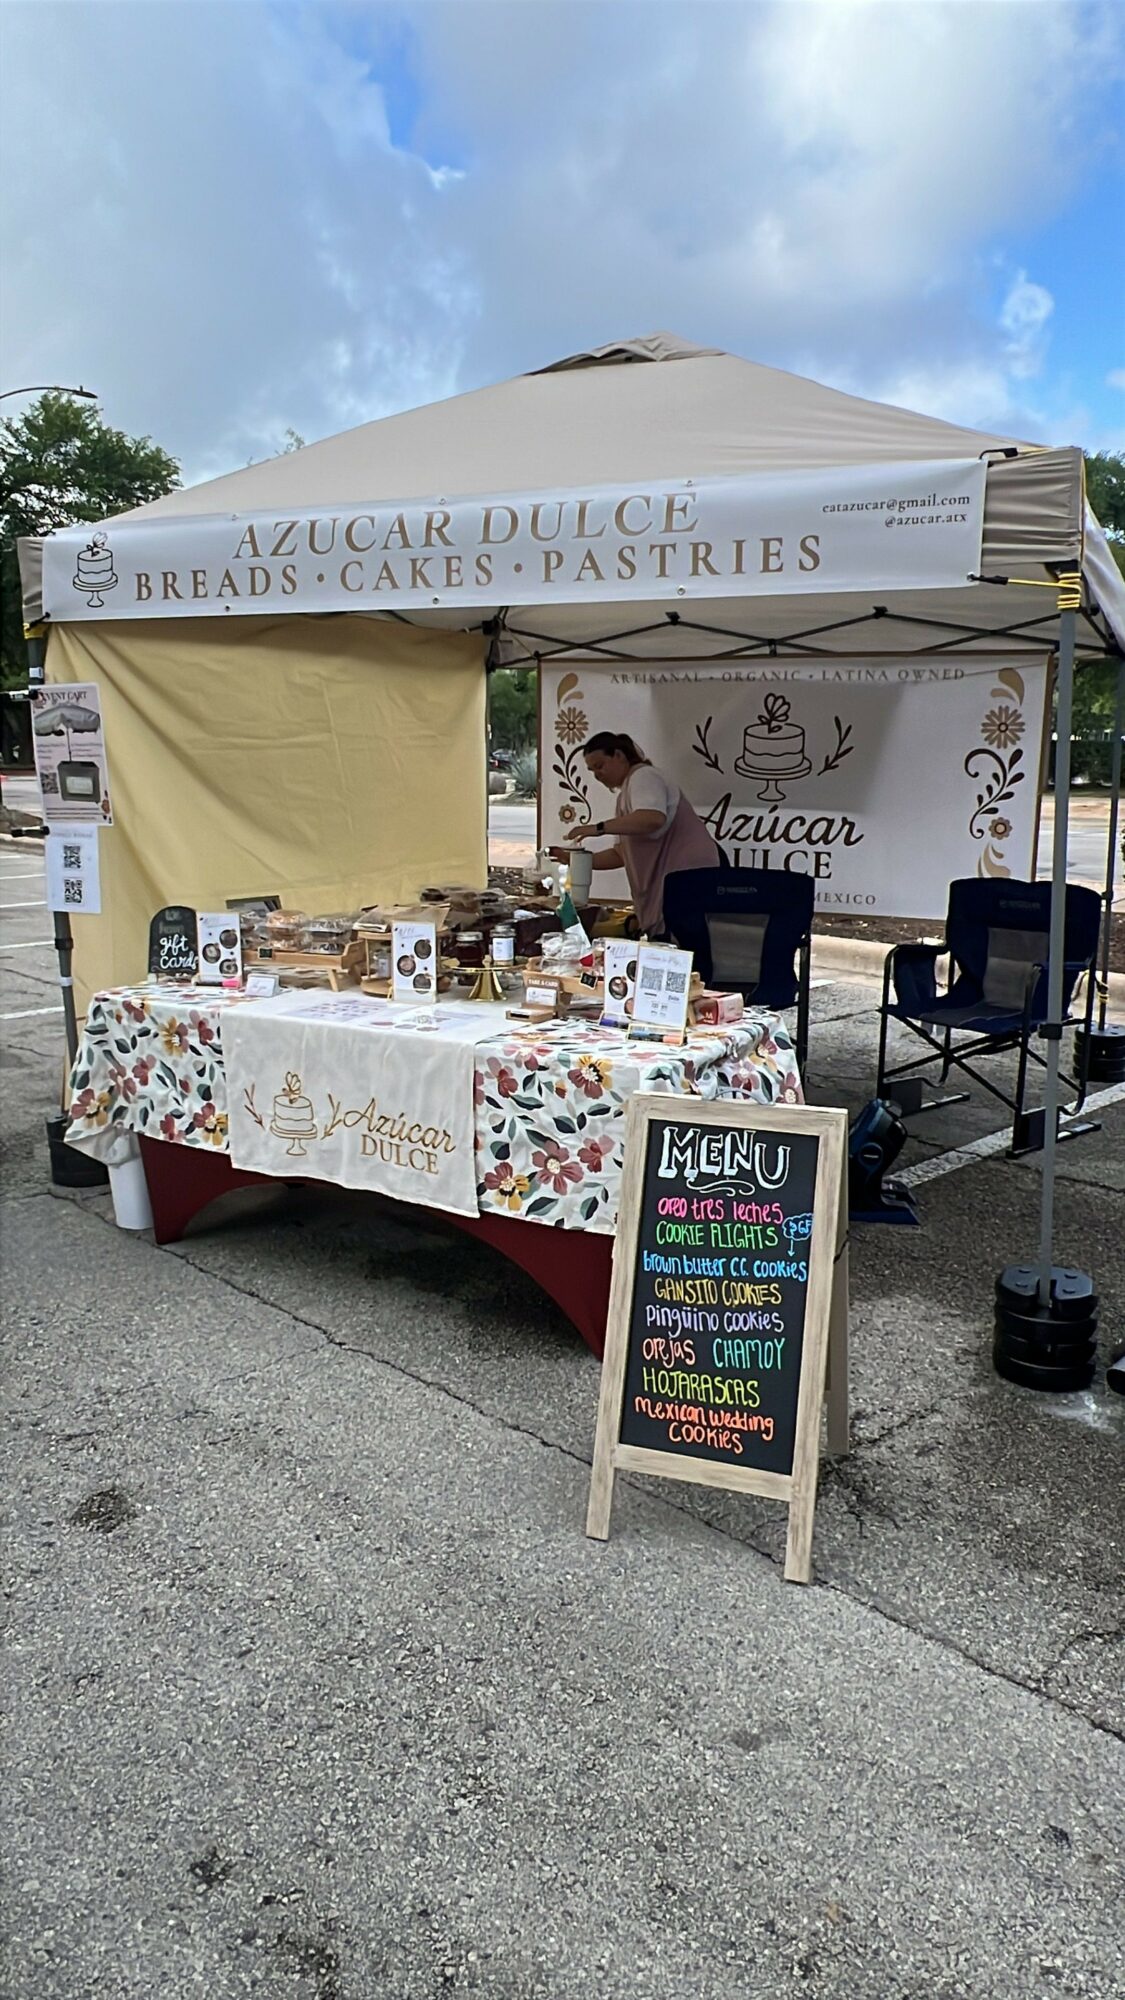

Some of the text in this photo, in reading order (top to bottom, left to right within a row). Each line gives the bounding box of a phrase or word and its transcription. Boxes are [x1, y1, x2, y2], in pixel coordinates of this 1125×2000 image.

[232, 491, 699, 560] AZUCAR DULCE
[885, 512, 967, 528] @azucar.atx
[135, 534, 820, 601] BREADS CAKES PASTRIES
[610, 668, 965, 684] ARTISANAL ORGANIC LATINA OWNED
[698, 792, 865, 847] Azúcar
[733, 847, 833, 880] ULCE
[159, 933, 189, 956] gift
[343, 1097, 457, 1154] Azúcar
[361, 1134, 439, 1175] DULCE
[657, 1126, 791, 1190] MENU
[658, 1197, 784, 1225] oreo tres leches
[656, 1220, 779, 1250] COOKIE FLIGHTS
[643, 1250, 682, 1275] brown
[683, 1254, 727, 1278] butter
[753, 1257, 808, 1282] cookies
[654, 1277, 782, 1308] GANSITO COOKIES
[723, 1310, 785, 1333] cookies
[712, 1337, 786, 1370] CHAMOY
[642, 1366, 761, 1408] HOJARASCAS
[634, 1396, 774, 1441] mexican wedding
